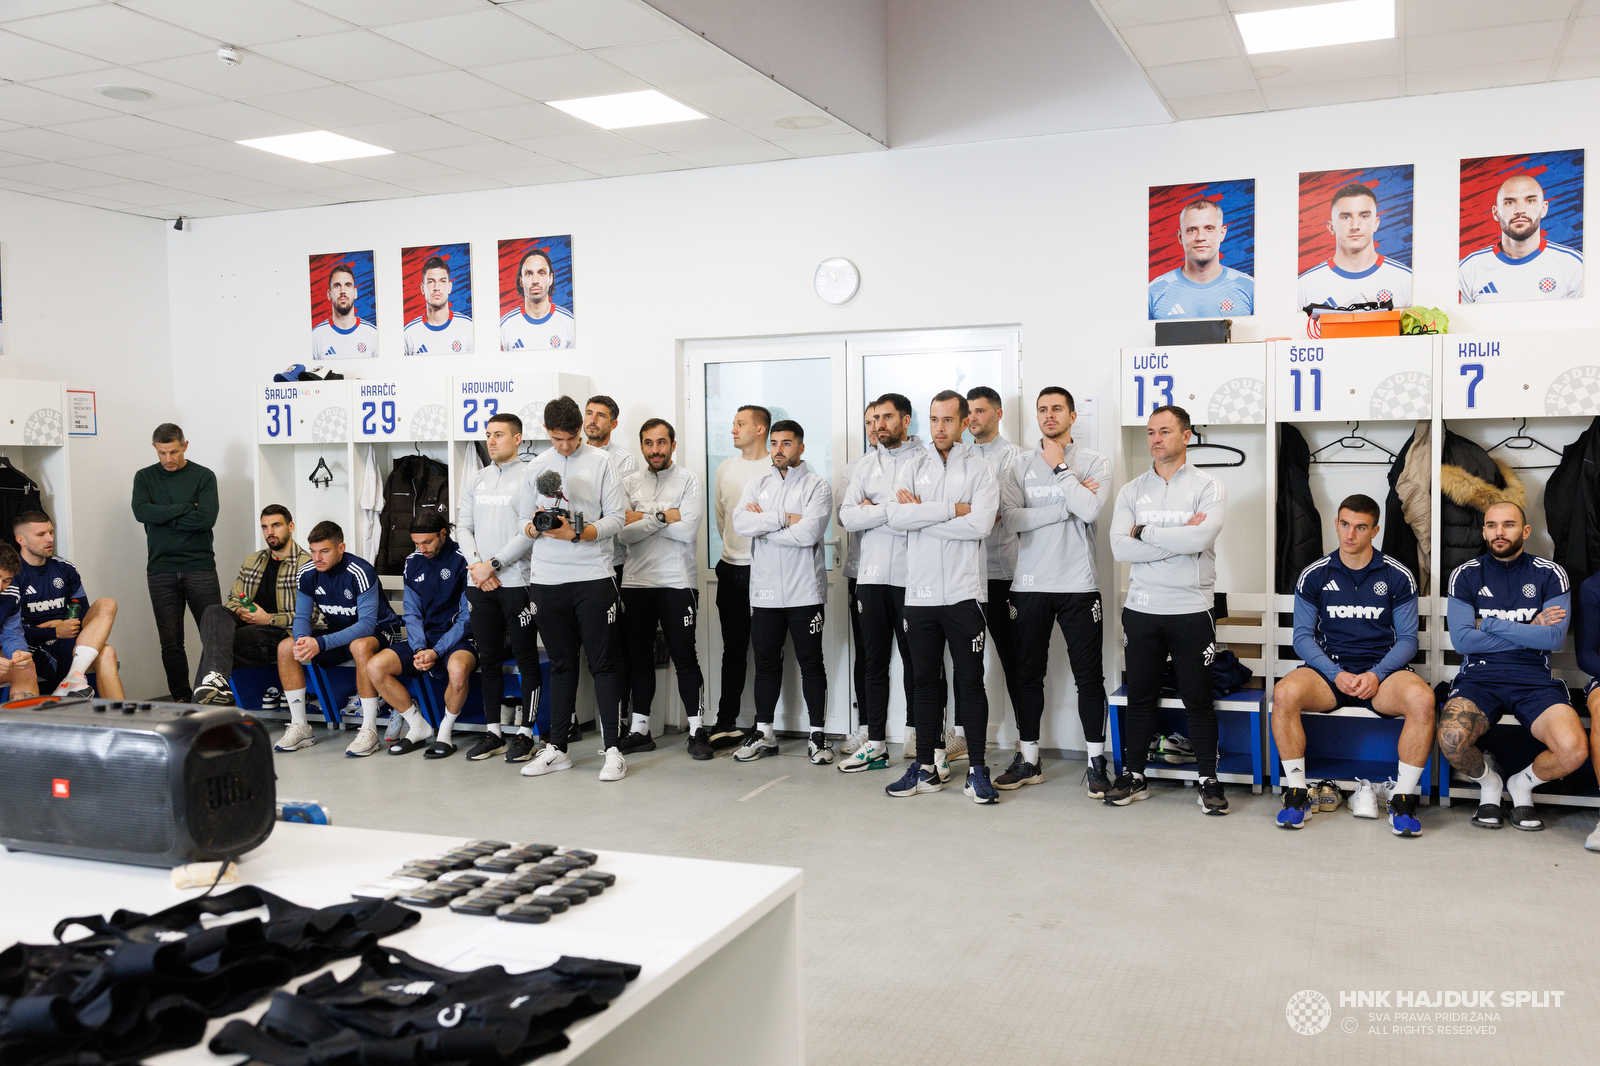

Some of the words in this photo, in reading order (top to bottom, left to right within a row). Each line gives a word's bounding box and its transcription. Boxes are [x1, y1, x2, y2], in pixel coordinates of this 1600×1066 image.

[1290, 346, 1324, 362] ŠEGO
[1458, 342, 1500, 357] KALIK
[1134, 353, 1168, 370] LUČIĆ
[265, 387, 298, 400] ŠARLIJA
[361, 382, 396, 397] KARAČIĆ
[462, 379, 514, 394] KROVINOVIĆ
[1290, 367, 1323, 413] 11
[1371, 372, 1431, 408] HAJDUK
[1459, 363, 1485, 409] 7
[1546, 366, 1600, 404] HAJDU
[1134, 374, 1175, 418] 13
[1209, 378, 1265, 413] HAJDUK
[24, 409, 62, 437] HAJDUK
[266, 404, 292, 437] 31
[311, 407, 347, 434] HAJDUK
[362, 400, 396, 435] 29
[410, 405, 447, 432] HAJDUK
[463, 398, 499, 433] 23
[475, 494, 513, 506] TOMMY
[1140, 510, 1193, 523] TOMMY
[27, 597, 65, 612] TOMMY
[319, 604, 357, 616] TOMMY
[1326, 605, 1385, 619] TOMMY
[520, 614, 531, 627] AP
[1479, 608, 1537, 622] TOMMY
